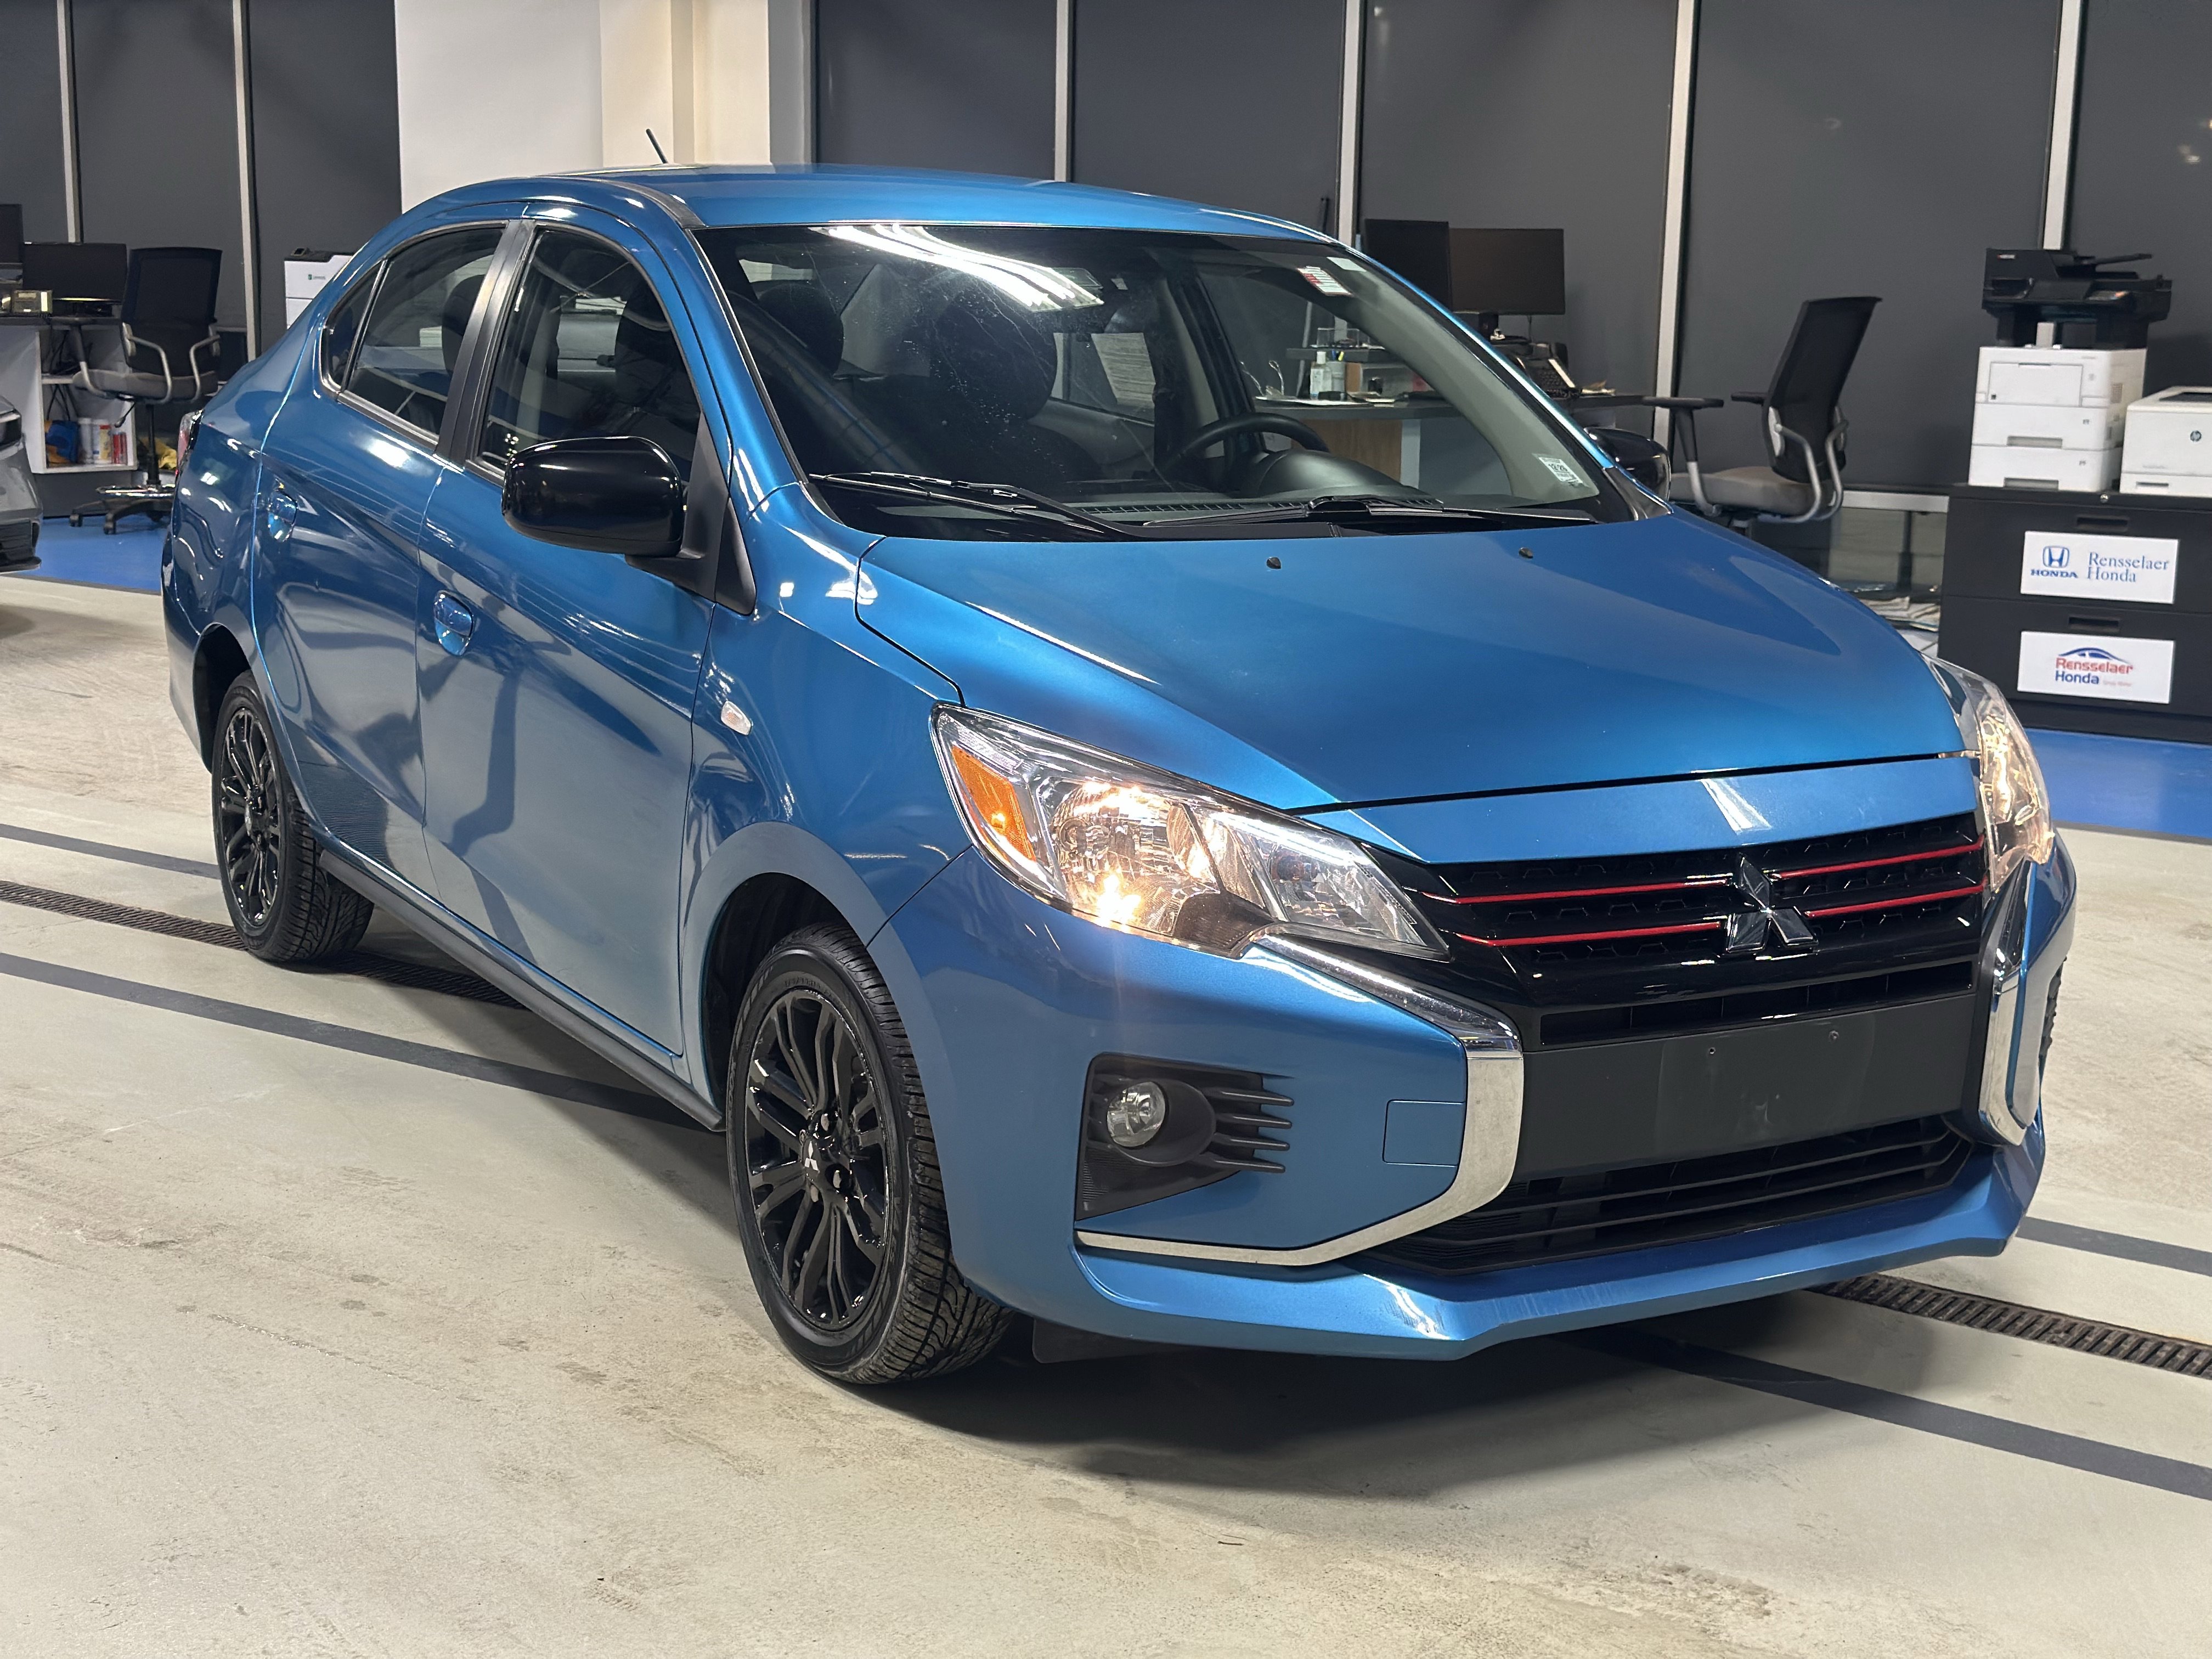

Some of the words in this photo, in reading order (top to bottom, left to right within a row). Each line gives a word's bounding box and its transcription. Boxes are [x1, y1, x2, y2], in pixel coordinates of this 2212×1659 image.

[2089, 551, 2170, 571] Rensselaer
[2030, 568, 2078, 579] HONDA
[2087, 566, 2136, 583] Honda
[2056, 657, 2134, 674] Rensselaer
[2055, 670, 2100, 685] Honda
